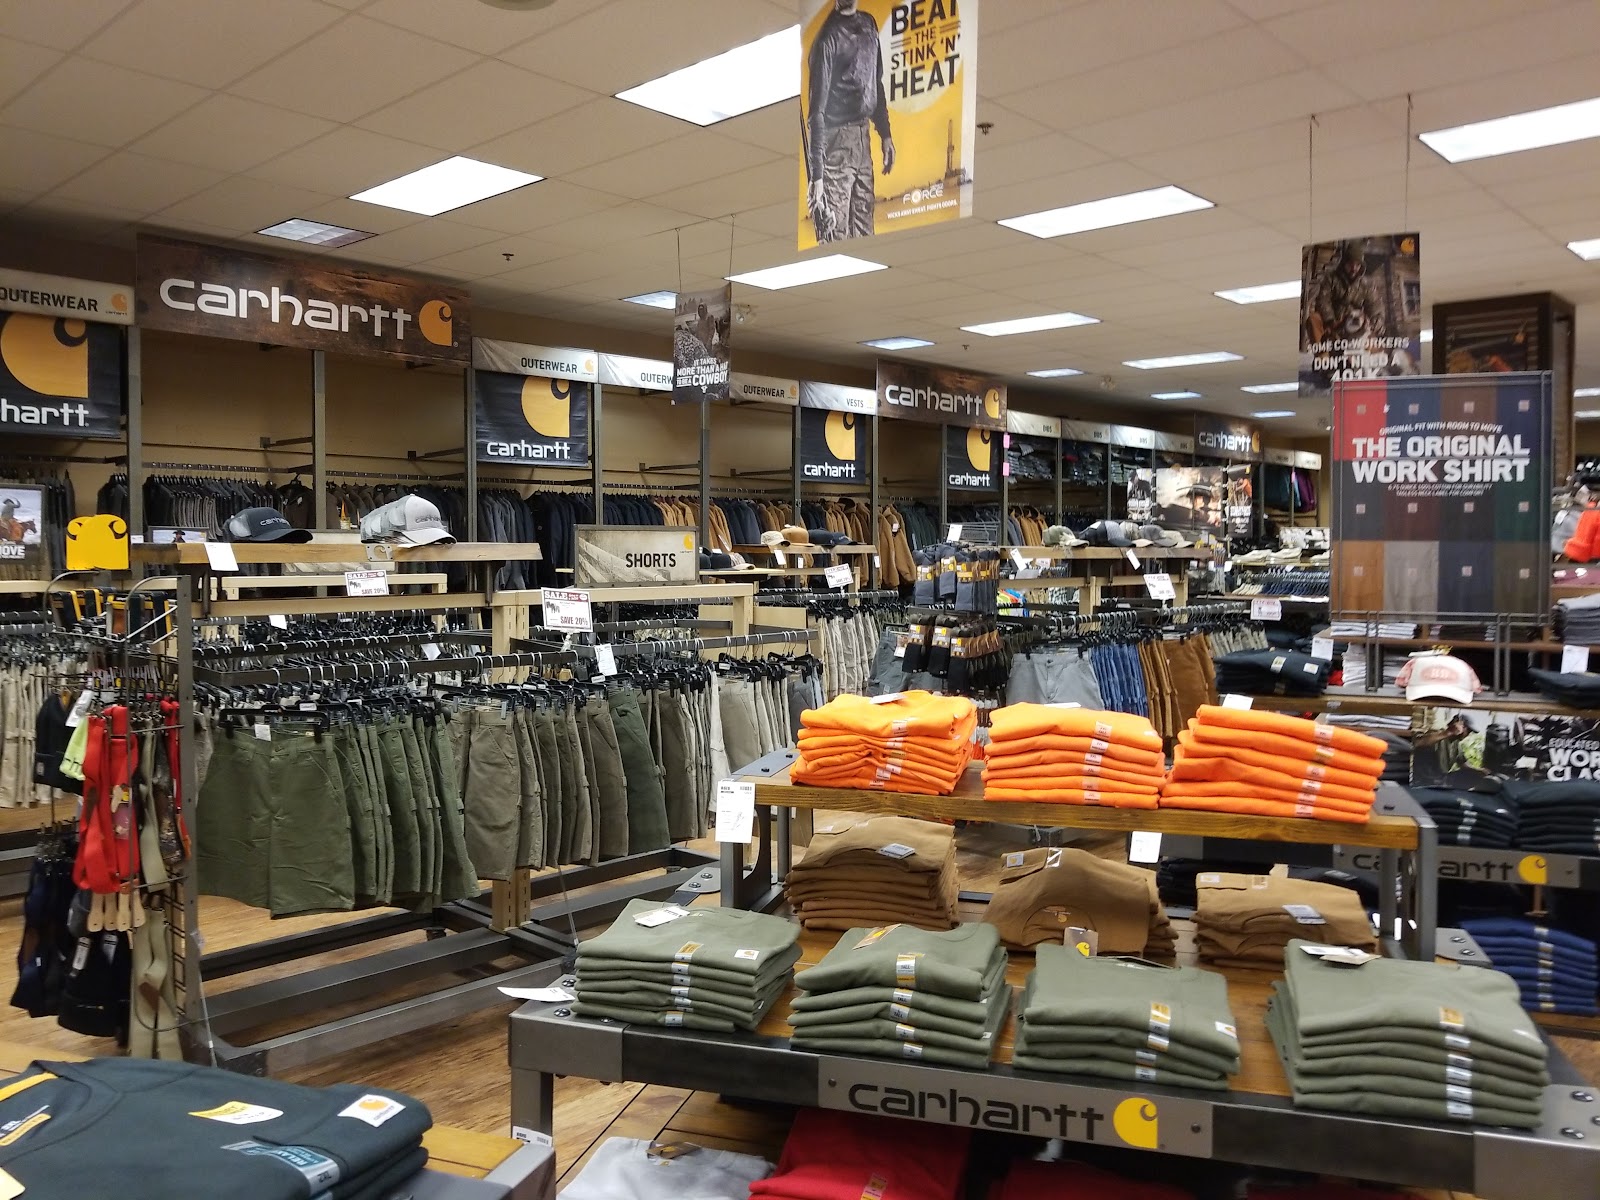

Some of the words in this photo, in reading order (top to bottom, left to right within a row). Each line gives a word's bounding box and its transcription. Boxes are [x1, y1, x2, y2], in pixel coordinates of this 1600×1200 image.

[915, 26, 937, 44] THE
[890, 41, 937, 70] STINK
[889, 54, 960, 102] HEAT
[903, 187, 944, 204] FORCE
[0, 287, 99, 312] OUTERWEAR
[159, 278, 412, 340] carhartt
[1307, 339, 1333, 354] SOME
[1334, 336, 1411, 351] CO-WORKERS
[521, 357, 578, 374] OUTERWEAR
[700, 357, 717, 365] TAKES
[1314, 355, 1349, 371] DON'T
[1350, 351, 1389, 369] NEED
[640, 372, 673, 385] OUTERW
[677, 366, 696, 377] MORE
[697, 364, 714, 374] THAN
[692, 369, 728, 387] COWBOY
[743, 384, 785, 399] OUTERWEAR
[885, 384, 983, 416] carhartt
[846, 397, 864, 408] VESTS
[1379, 424, 1414, 436] ORIGINAL
[1414, 422, 1426, 431] FIT
[1426, 421, 1446, 430] WITH
[1446, 421, 1469, 431] ROOM
[1470, 421, 1480, 431] TO
[1481, 422, 1503, 433] MOVE
[487, 439, 570, 460] carhartt
[1198, 431, 1251, 453] carhartt
[1352, 437, 1402, 459] THE
[1406, 434, 1530, 459] ORIGINAL
[804, 461, 856, 478] carhartt
[1352, 459, 1440, 484] WORK
[1443, 458, 1530, 483] SHIRT
[948, 472, 991, 488] carhartt
[0, 545, 25, 556] OVE
[625, 552, 676, 568] SHORTS
[544, 590, 568, 600] SALE
[560, 615, 574, 625] SAVE
[575, 617, 588, 626] 20%
[1549, 738, 1600, 750] EDUCATED
[849, 1083, 1104, 1141] carhartt
